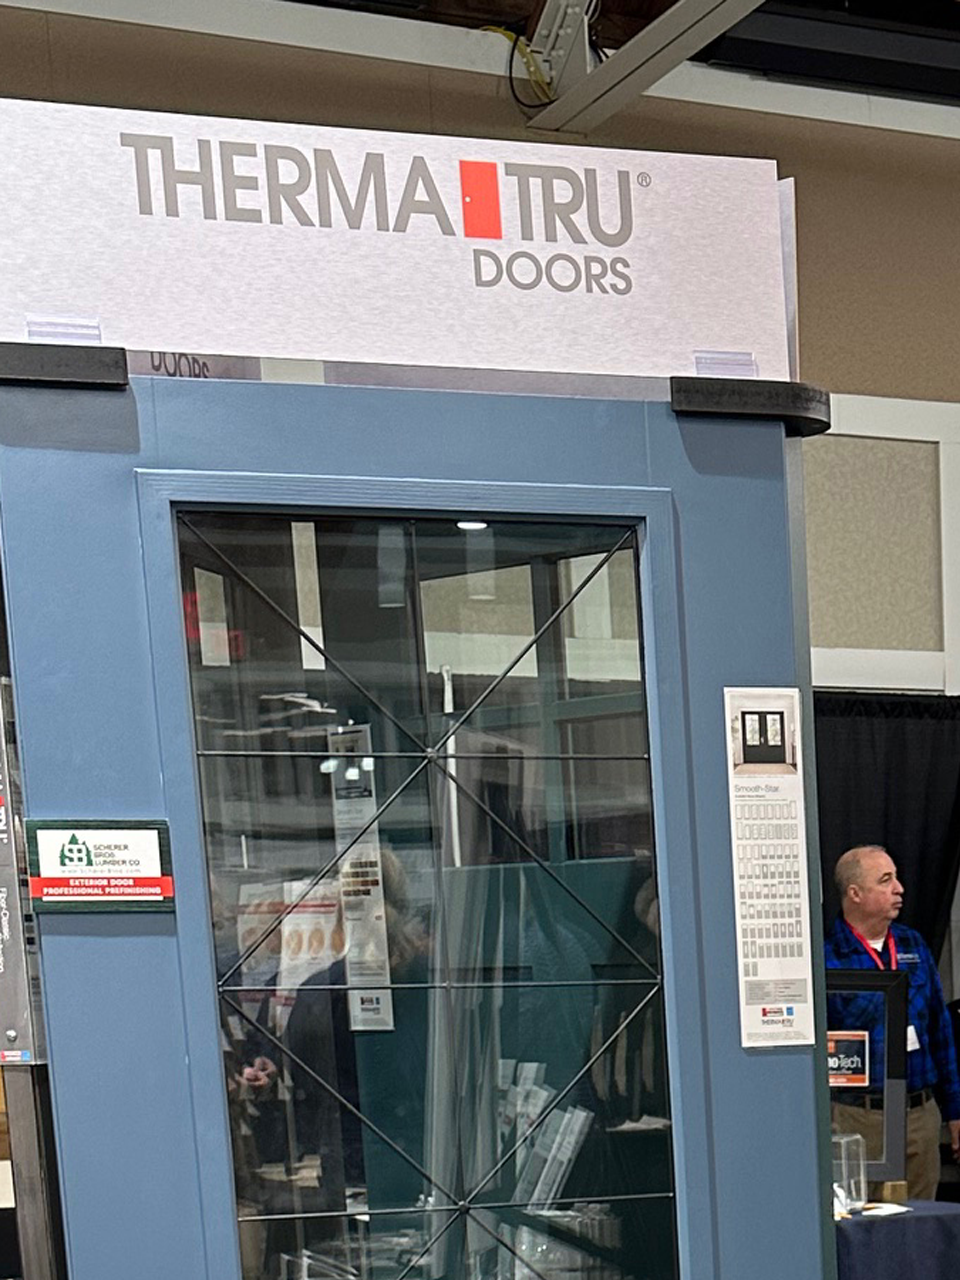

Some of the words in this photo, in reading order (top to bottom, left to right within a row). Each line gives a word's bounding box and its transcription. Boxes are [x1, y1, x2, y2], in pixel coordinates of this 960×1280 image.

[474, 248, 634, 296] DOORS
[69, 878, 108, 886] EXTERIOR
[110, 878, 134, 886] DOOR
[43, 886, 103, 895] PROFESSIONAL
[105, 886, 161, 895] PREFINISHING
